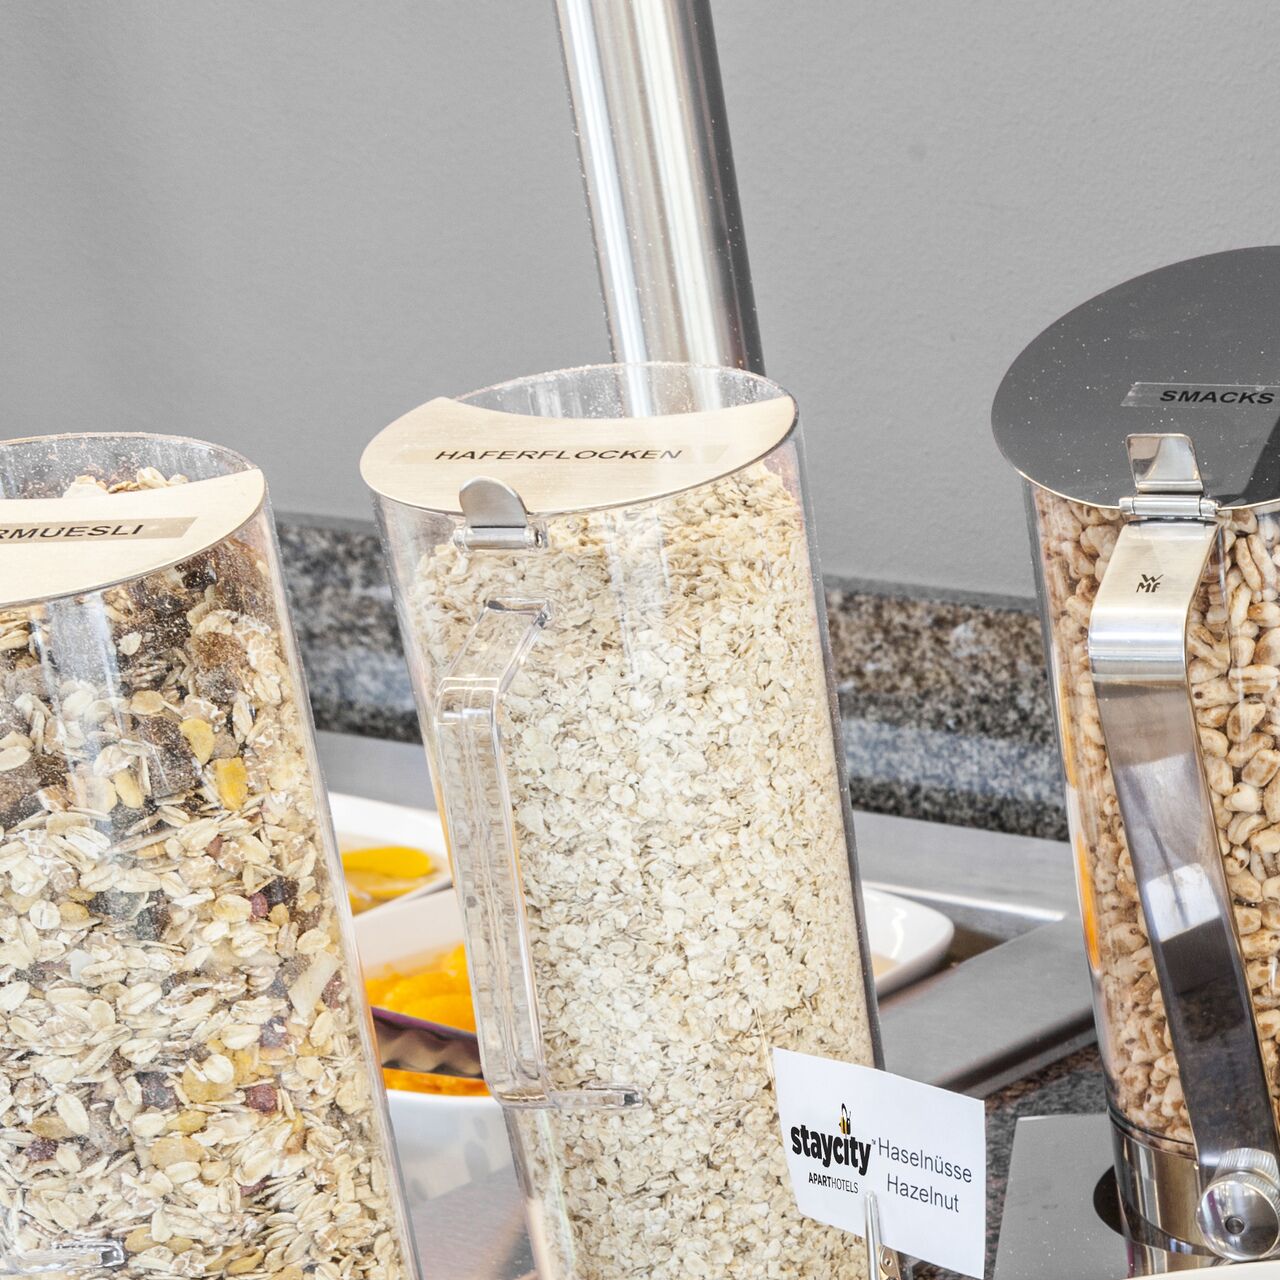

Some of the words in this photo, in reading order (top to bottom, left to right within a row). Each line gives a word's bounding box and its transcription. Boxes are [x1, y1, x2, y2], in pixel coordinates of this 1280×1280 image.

[1160, 390, 1275, 405] SMACKS
[434, 449, 683, 461] HAFERFLOCKEN
[878, 1136, 973, 1183] Haselnüsse
[808, 1171, 859, 1194] APARTHOTELS
[887, 1172, 960, 1213] Hazelnut
